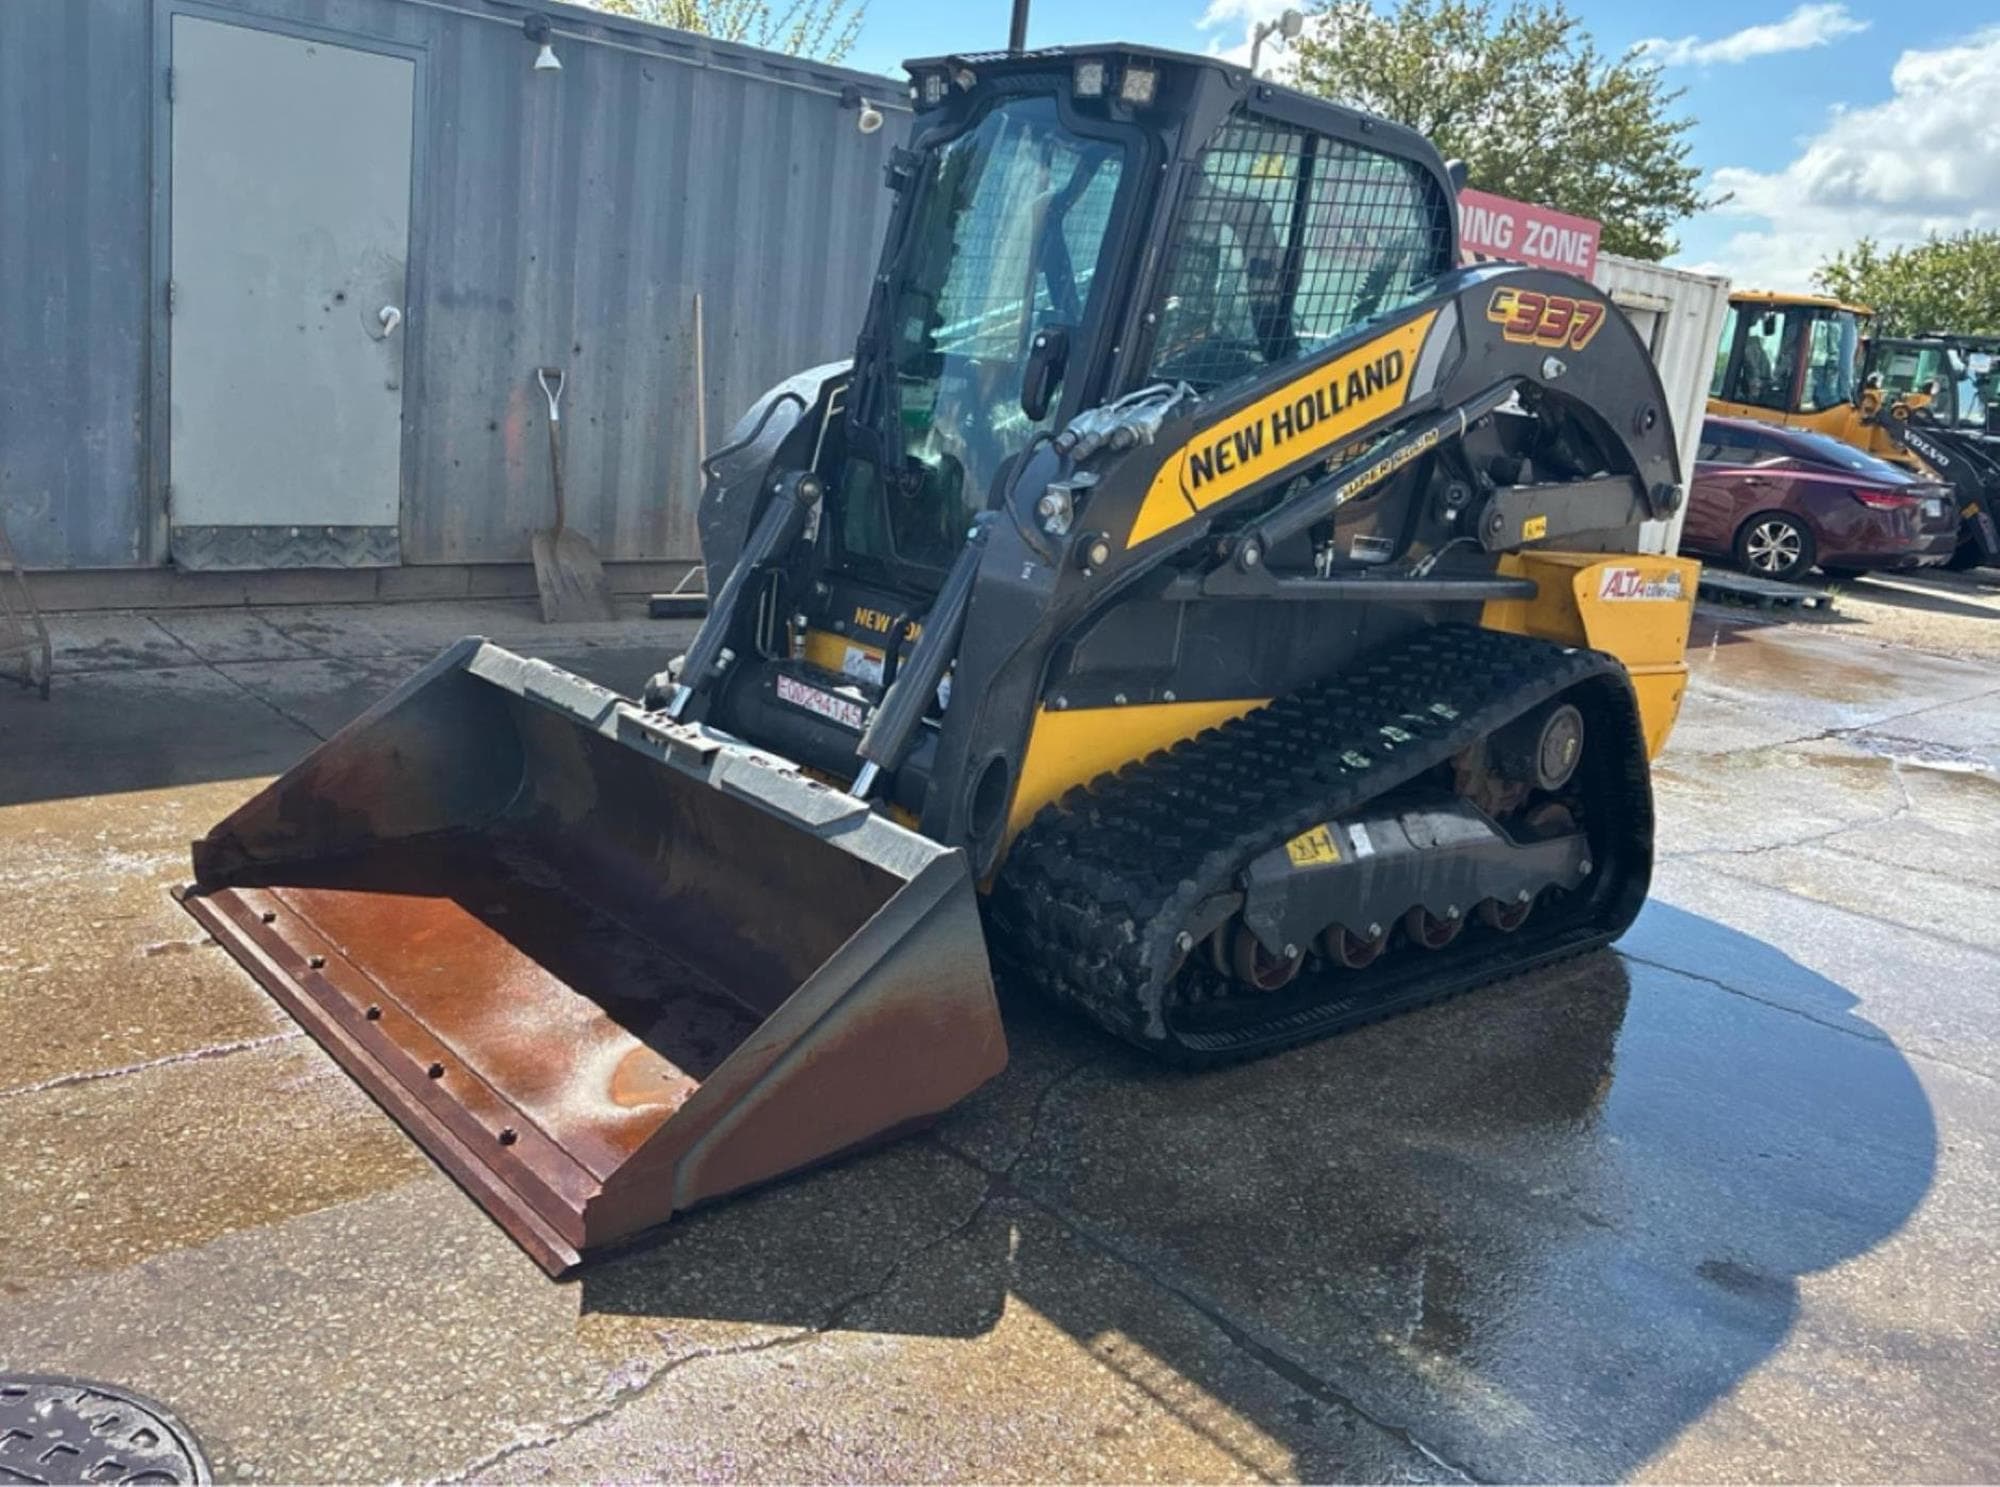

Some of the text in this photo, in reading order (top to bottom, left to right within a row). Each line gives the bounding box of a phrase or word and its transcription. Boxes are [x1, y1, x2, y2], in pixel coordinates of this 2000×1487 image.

[1522, 219, 1592, 267] ZONE
[1190, 350, 1404, 489] NEW HOLLAND
[1904, 429, 1949, 466] VOLVO
[854, 607, 891, 633] NEW
